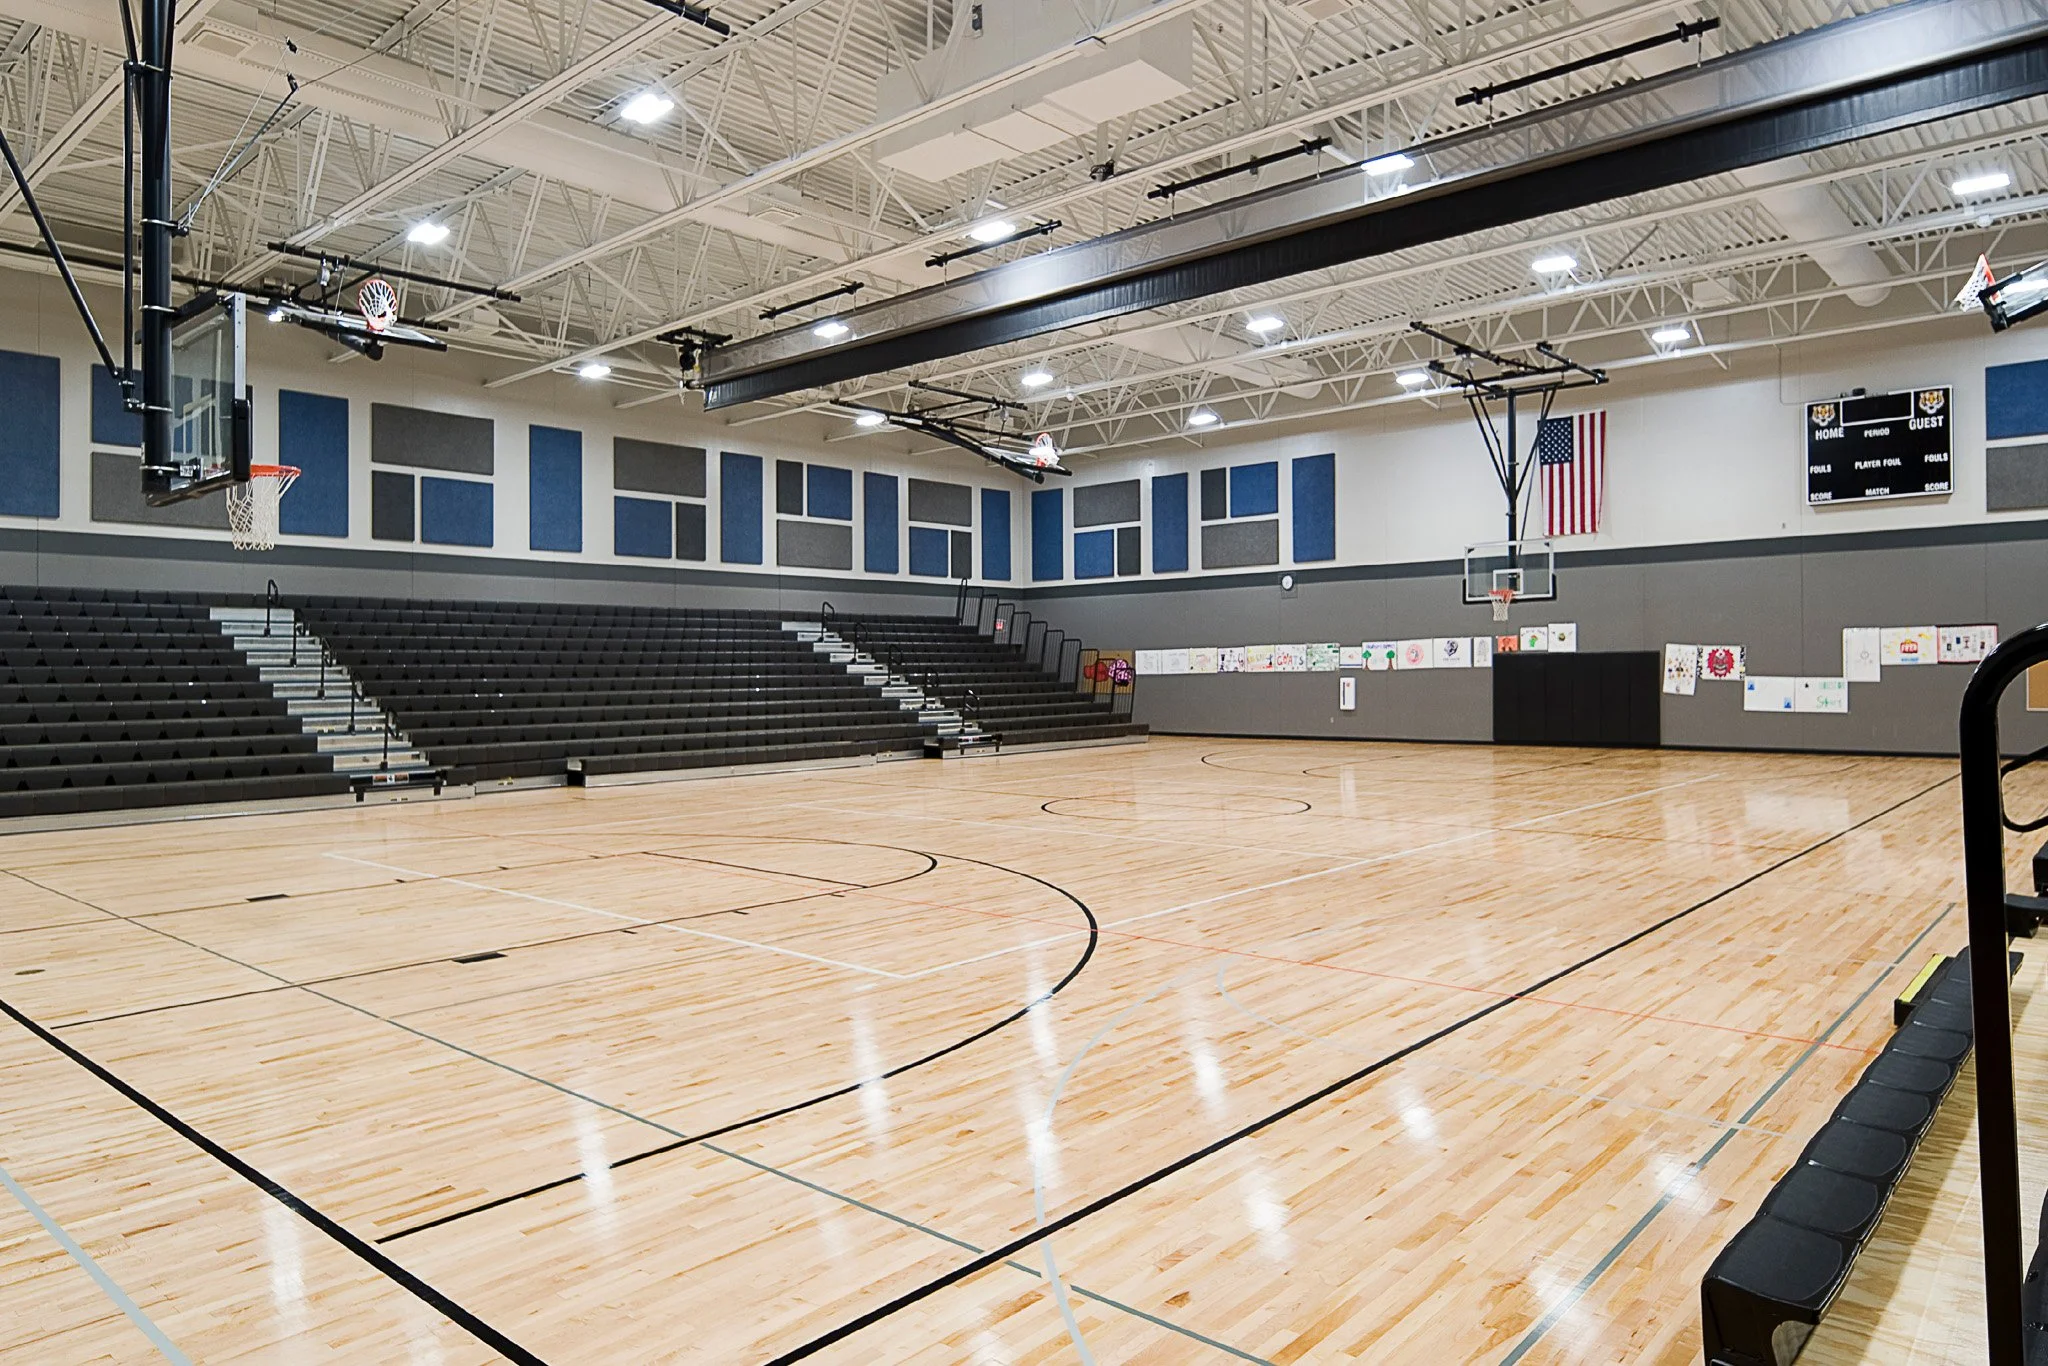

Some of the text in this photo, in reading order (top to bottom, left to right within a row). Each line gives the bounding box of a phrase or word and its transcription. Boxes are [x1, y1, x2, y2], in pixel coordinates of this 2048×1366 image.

[1908, 415, 1944, 431] GUEST
[1815, 427, 1845, 441] HOME
[1864, 427, 1890, 438] PERIOD
[1924, 452, 1949, 463] FOULS
[1854, 457, 1902, 470] PLAYER FOUL
[1809, 464, 1832, 475] FOULS
[1865, 487, 1890, 496] MATCH
[1924, 481, 1949, 492] SCORE
[1810, 491, 1833, 502] SCORE
